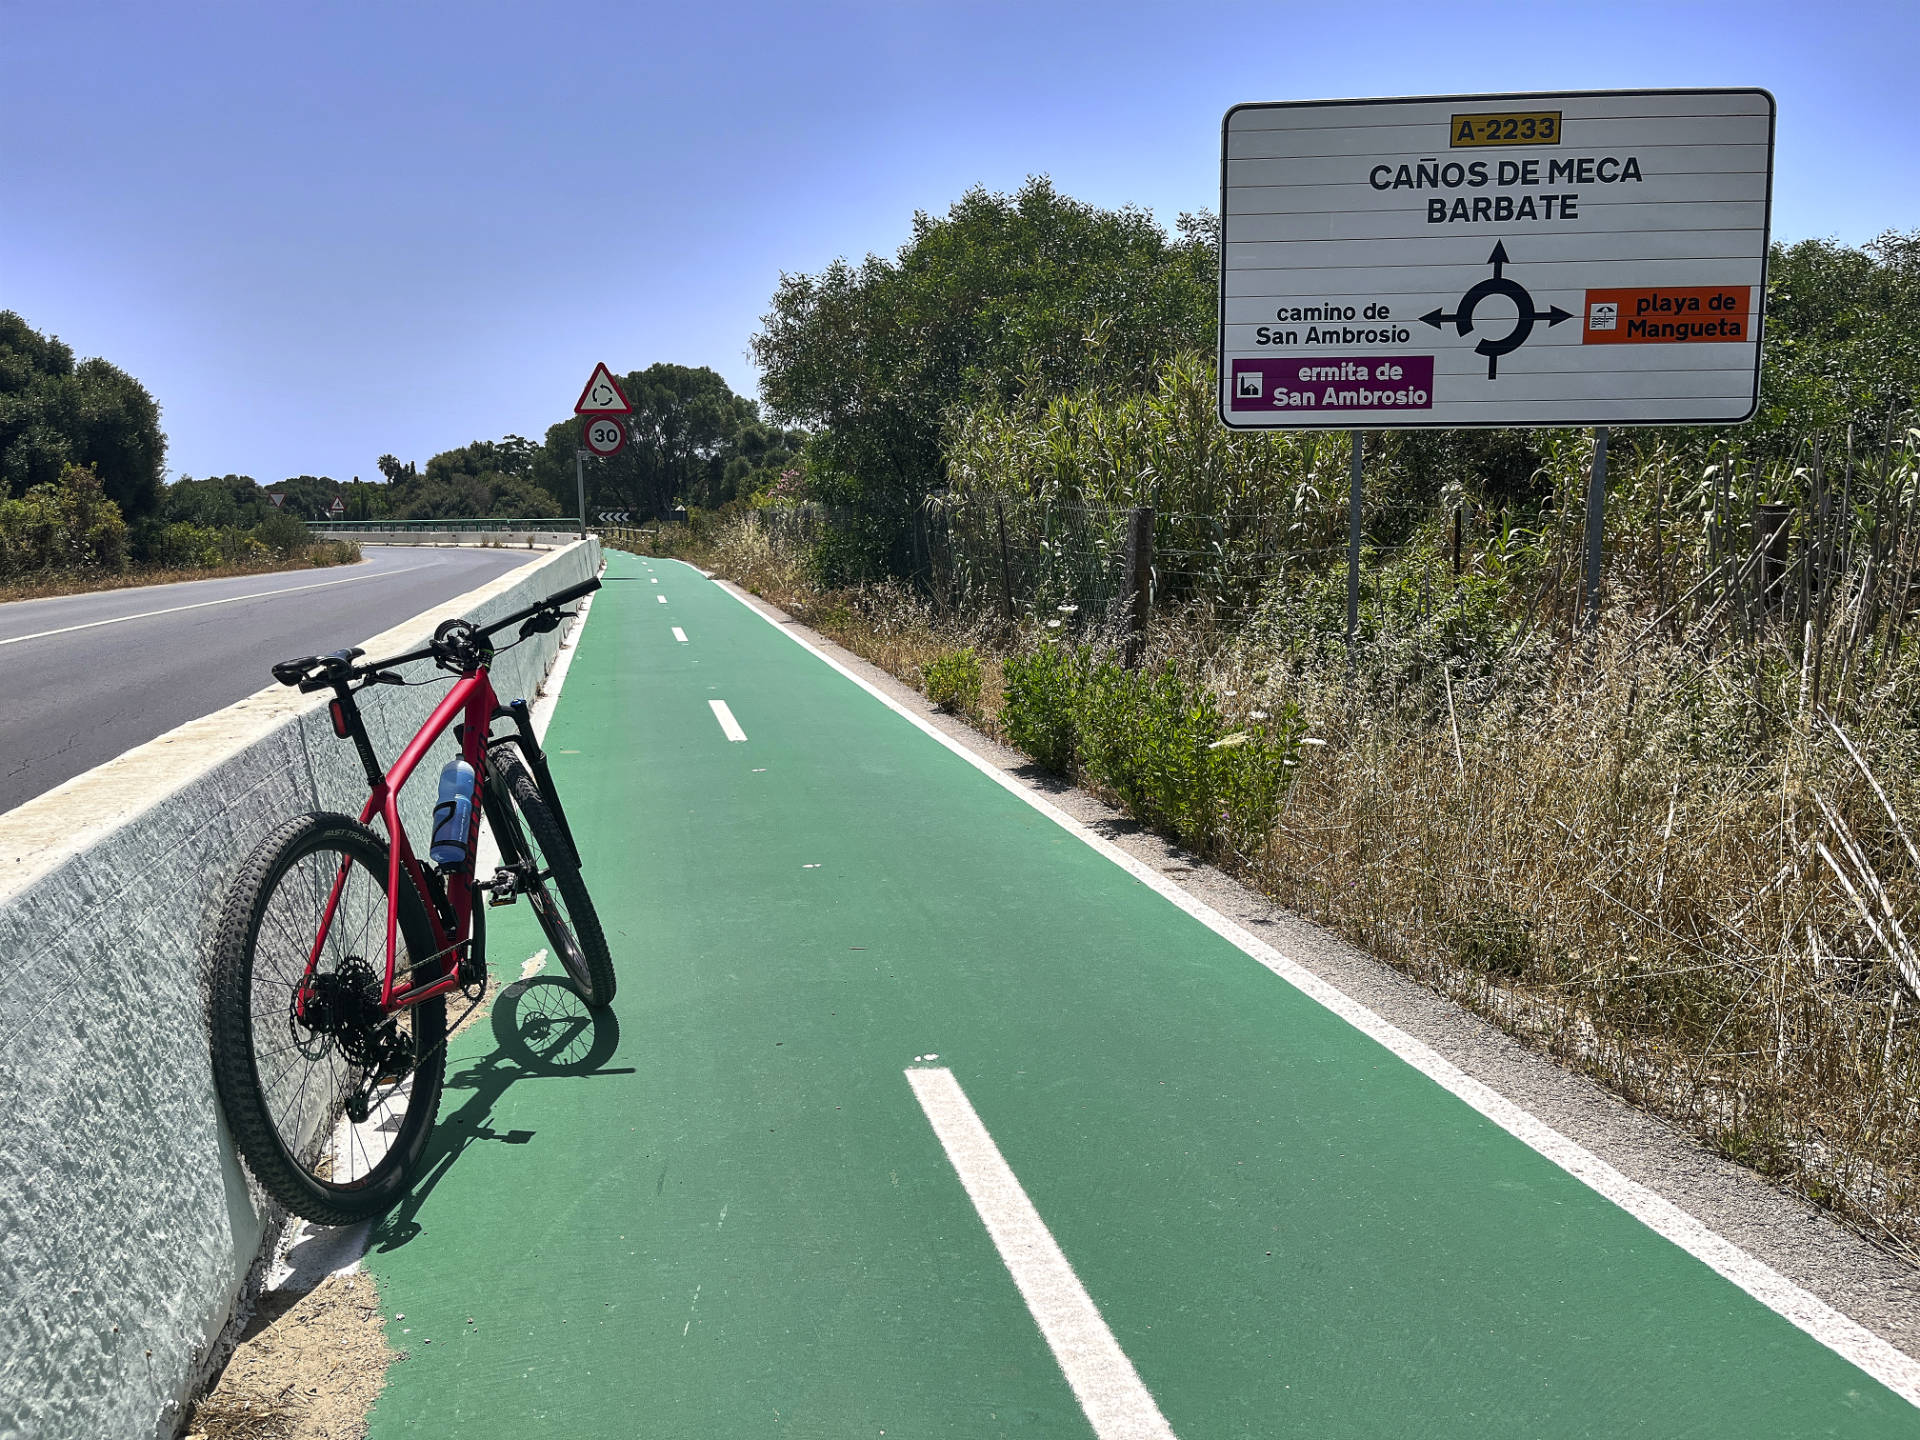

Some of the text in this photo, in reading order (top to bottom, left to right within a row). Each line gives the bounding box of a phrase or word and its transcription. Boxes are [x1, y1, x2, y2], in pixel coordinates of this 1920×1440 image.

[1457, 118, 1555, 141] A-2233
[1369, 157, 1642, 190] CAÑOS DE MECA
[1427, 194, 1579, 223] BARBATE
[1277, 302, 1390, 321] camino de
[1637, 293, 1736, 316] playa de
[1256, 325, 1410, 345] San Ambrosio
[1627, 318, 1741, 341] Mangueta
[1298, 362, 1403, 381] ermita de
[1273, 386, 1427, 406] San Ambrosio
[595, 429, 617, 442] 30
